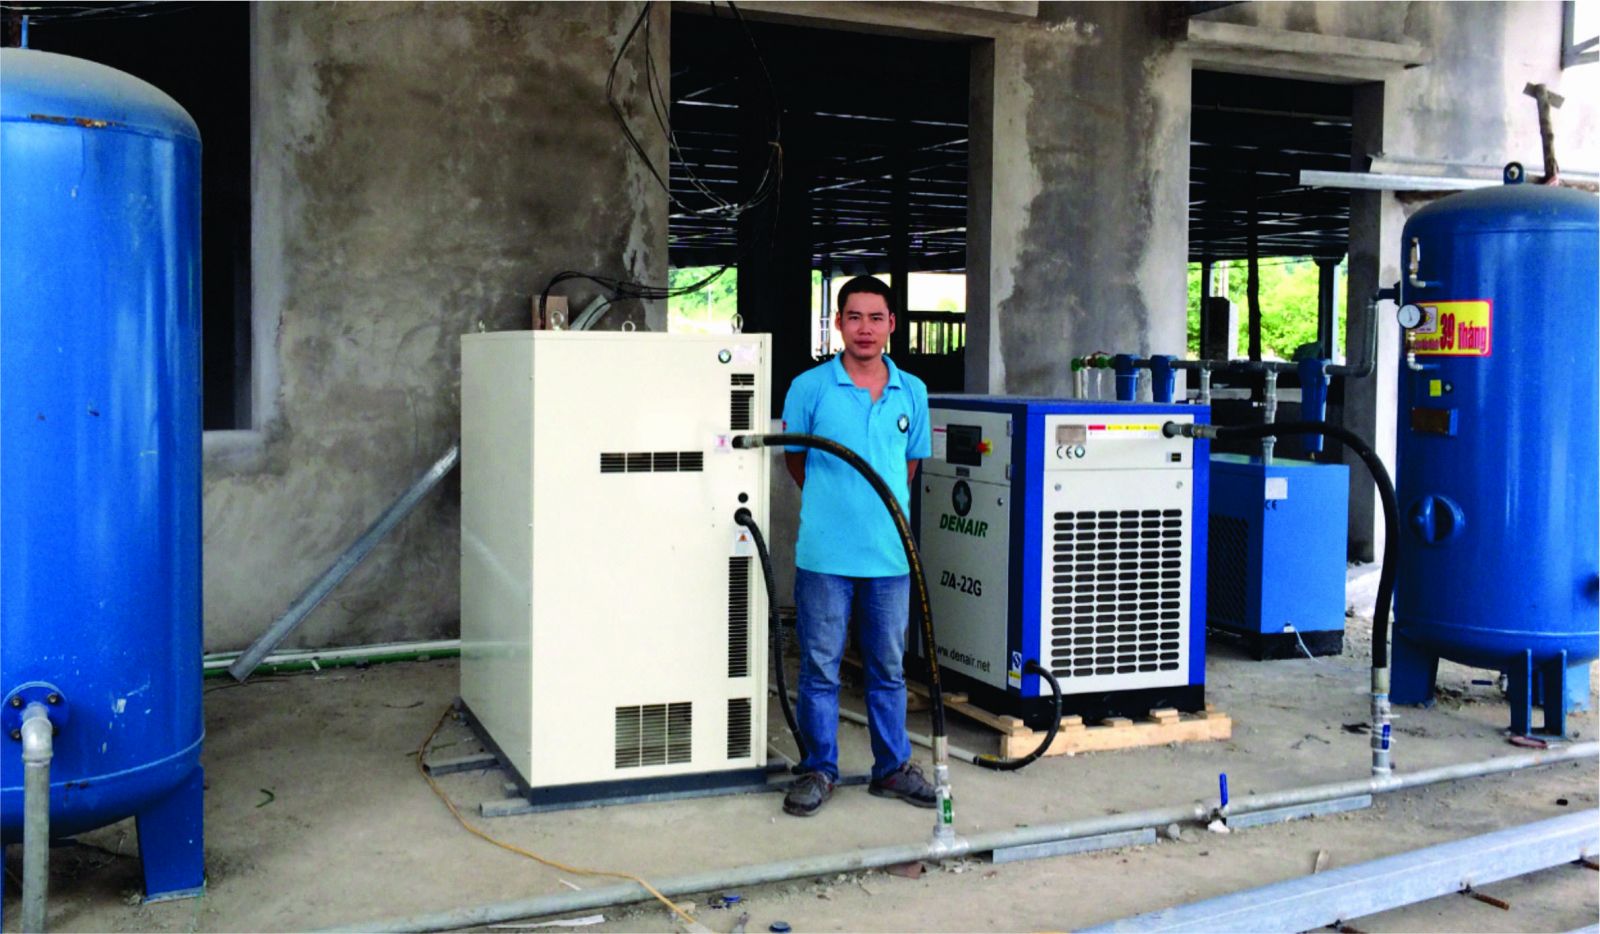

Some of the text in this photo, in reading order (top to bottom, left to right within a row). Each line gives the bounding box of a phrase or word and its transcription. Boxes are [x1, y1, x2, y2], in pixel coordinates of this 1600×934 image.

[1440, 312, 1455, 351] 39
[939, 513, 989, 538] DENAIR
[940, 570, 983, 597] DA-22G
[936, 645, 991, 673] ww.denair.net
